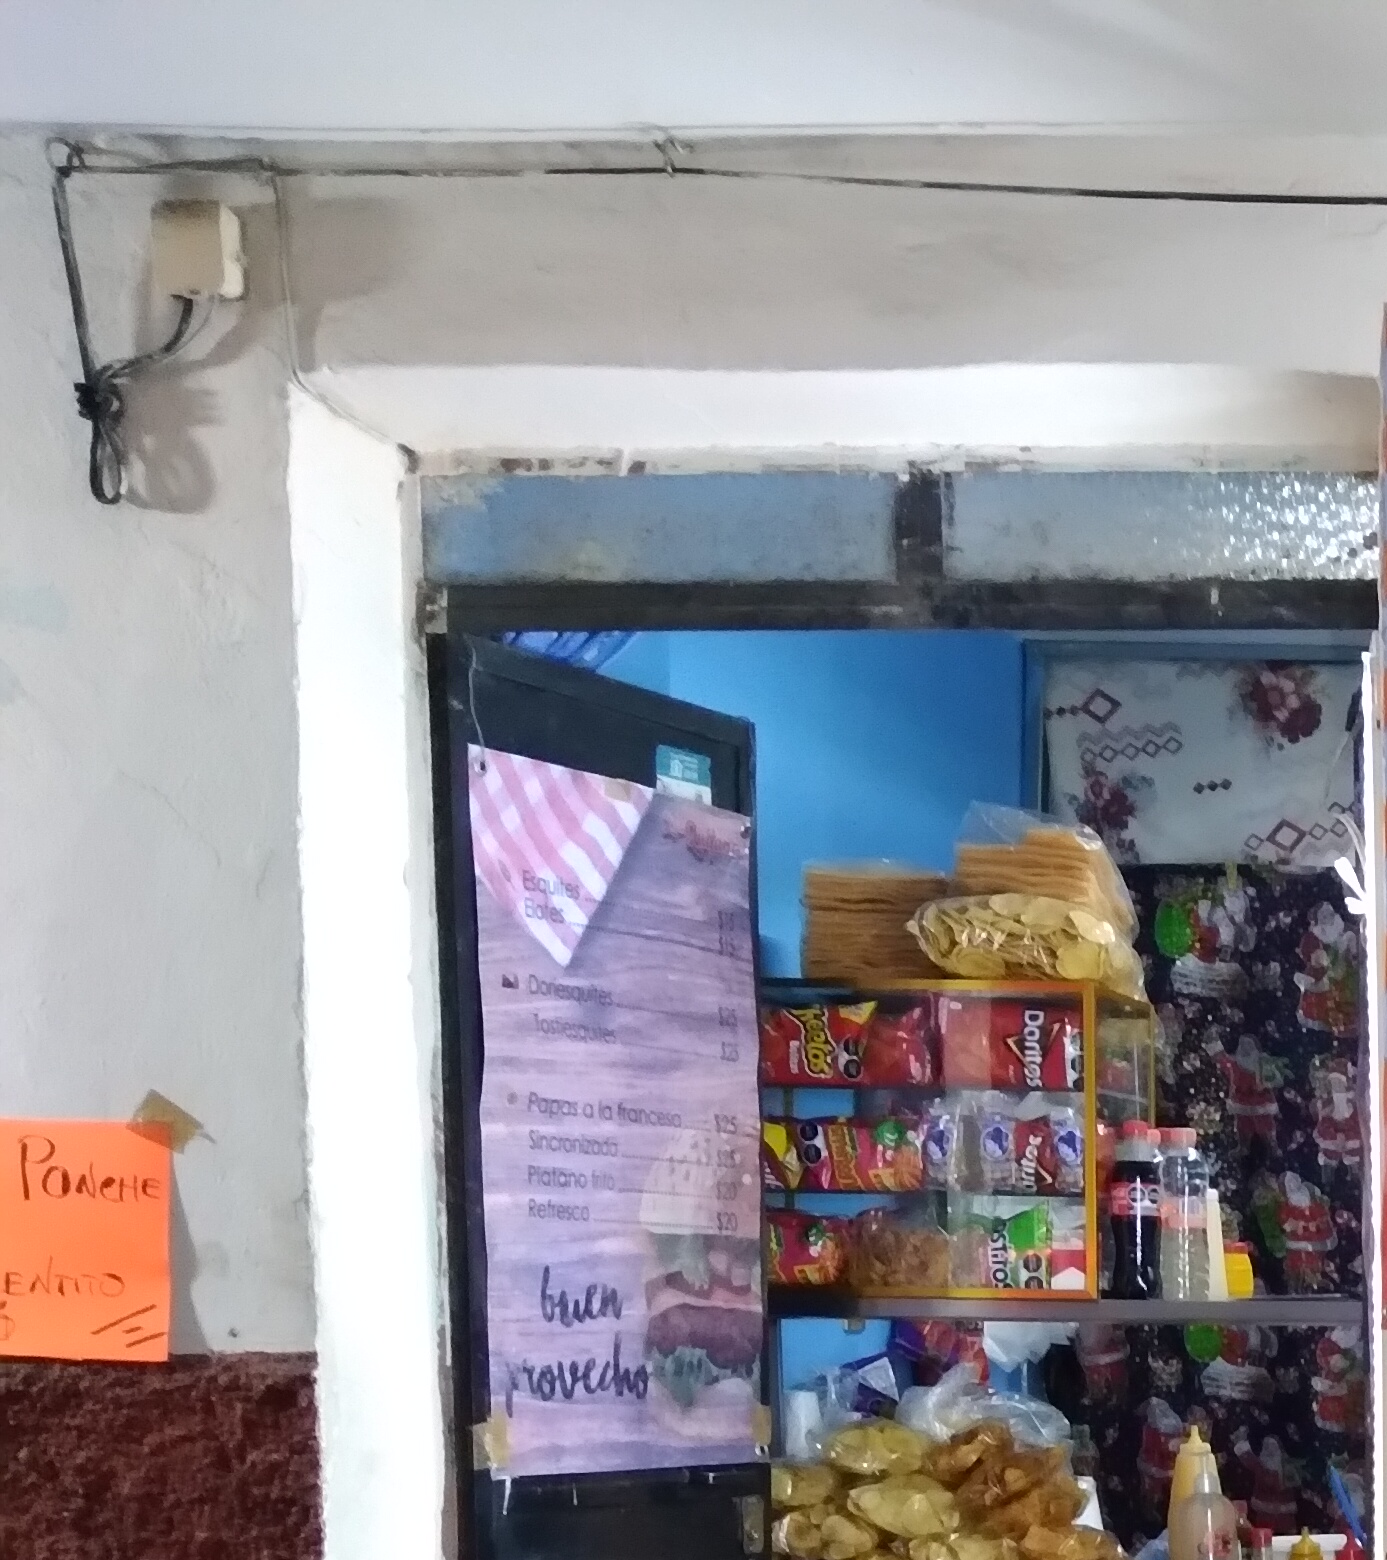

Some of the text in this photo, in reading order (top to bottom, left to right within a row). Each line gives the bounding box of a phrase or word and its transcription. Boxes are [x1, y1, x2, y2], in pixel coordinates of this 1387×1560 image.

[1024, 1009, 1045, 1088] Doritos
[528, 1091, 578, 1117] Papas
[583, 1103, 594, 1115] a
[598, 1101, 613, 1121] la
[617, 1102, 682, 1129] francesa
[528, 1130, 619, 1158] Sincronizada
[528, 1198, 590, 1222] Refresco
[540, 1265, 623, 1328] buen
[505, 1330, 650, 1418] provecho
